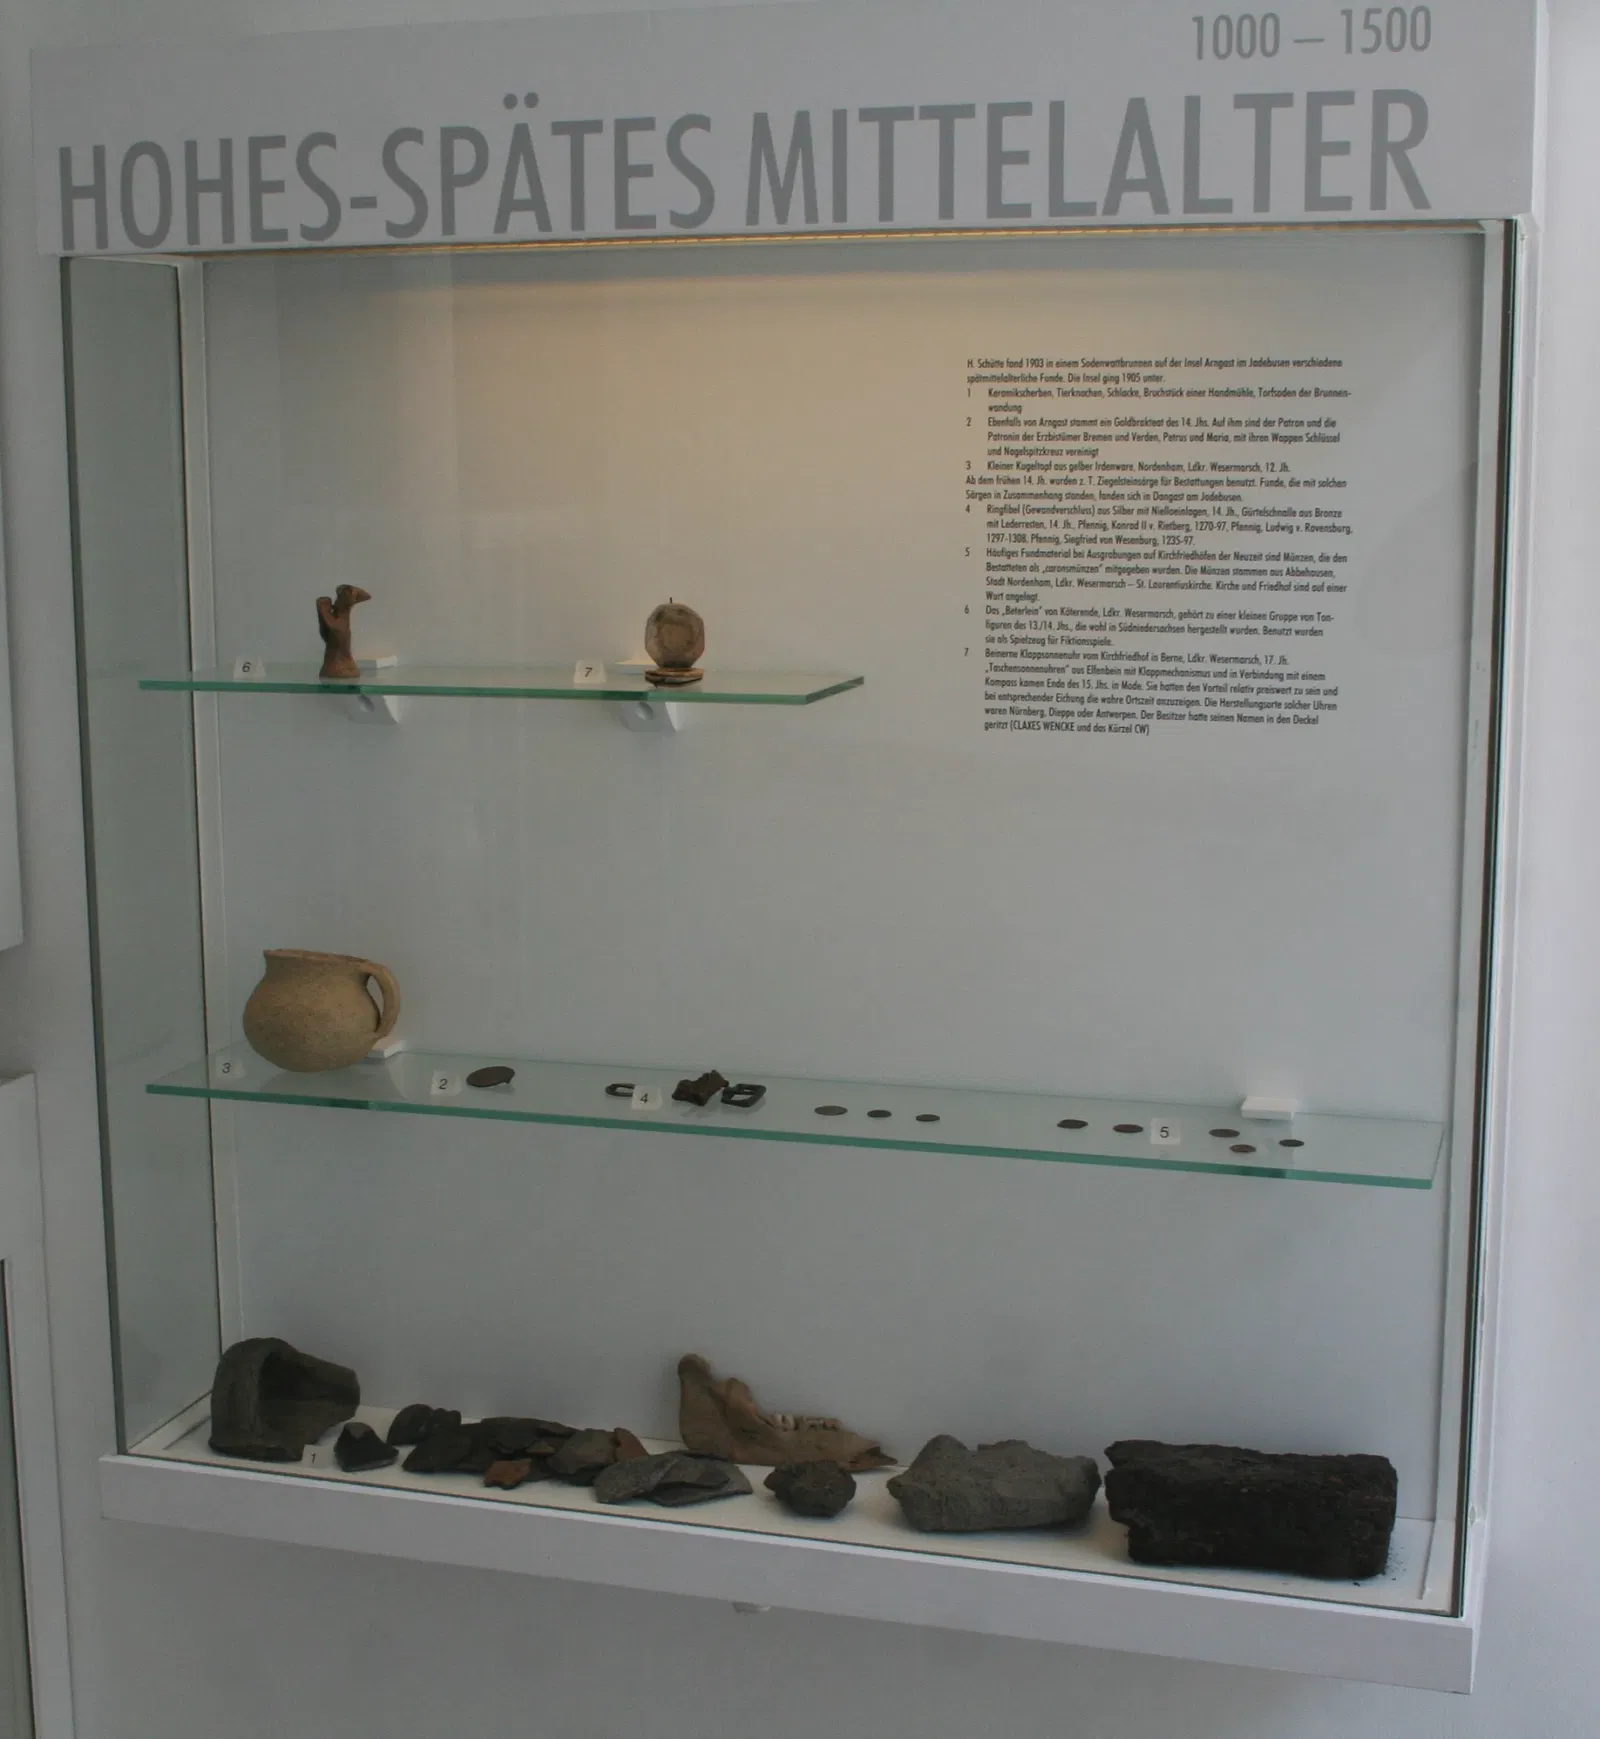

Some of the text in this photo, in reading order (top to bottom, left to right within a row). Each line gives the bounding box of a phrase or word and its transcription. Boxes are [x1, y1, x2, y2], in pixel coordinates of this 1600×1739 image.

[1192, 12, 1281, 61] 1000
[1341, 5, 1432, 54] 1500
[58, 88, 1431, 251] HOHES-SPÄTES MITTELALTER
[977, 357, 1342, 370] Schütte fand 1903 einem Insel Arngast Jadebusen verschiedene
[1082, 373, 1100, 383] Insel
[1102, 373, 1120, 385] ging
[987, 388, 1053, 399] Keramikscherben,
[1056, 388, 1104, 399] Tierknochen,
[1106, 388, 1141, 399] Schlacke,
[1142, 388, 1184, 398] Bruchstück
[1185, 388, 1206, 398] einer
[1208, 388, 1254, 399] Handmühle,
[1313, 388, 1352, 398] Brunnen-
[988, 402, 1022, 415] wandung
[987, 417, 1021, 427] Ebenfalls
[1038, 417, 1068, 430] Arngast
[1069, 417, 1098, 427] stammt
[1277, 417, 1304, 428] Patron
[987, 432, 1340, 445] Patronin Erzbistümer Bremen Verden, Petrus ihren Wappen Schlüssel
[1065, 446, 1099, 459] vereinigt
[986, 460, 1261, 474] Kleiner Kugeltopf gelber Nordenham, Wesermarsch,
[995, 475, 1020, 485] frühen
[1049, 475, 1078, 486] wurden
[1096, 476, 1158, 489] Ziegelsteinsärge
[1173, 476, 1224, 489] Bestattungen
[1259, 477, 1285, 489] Funde,
[1317, 477, 1346, 488] solchen
[965, 489, 992, 502] Särgen
[1002, 490, 1063, 503] Zusammenhang
[1064, 490, 1096, 502] standen,
[1098, 490, 1125, 501] fanden
[1152, 491, 1184, 504] Dangast
[986, 504, 1020, 517] Ringfibel
[1021, 504, 1095, 518] (Gewandverschluss)
[1112, 505, 1134, 516] Silber
[1241, 506, 1297, 517] Gürtelschnalle
[1314, 507, 1342, 517] Bronze
[1000, 519, 1352, 535] Lederresten, Pfennig, Konrad Rietberg, Pfennig, Ludwig Ravensburg,
[1030, 534, 1060, 547] Pfennig,
[1063, 534, 1098, 547] Siegfried
[1114, 535, 1159, 548] Wesenburg,
[985, 548, 1315, 564] Häufiges Fundmaterial Ausgrabungen Kirchfriedhöfen Neuzeit Münzen,
[985, 562, 1027, 573] Bestatteten
[1104, 564, 1150, 577] mitgegeben
[1199, 565, 1230, 576] Münzen
[1232, 566, 1268, 577] stammen
[1284, 567, 1334, 579] Abbehausen,
[985, 576, 1005, 587] Stadt
[1006, 577, 1052, 589] Nordenham,
[1076, 578, 1126, 589] Wesermarsch
[1215, 580, 1240, 591] Kirche
[1258, 581, 1292, 592] Friedhof
[1326, 582, 1346, 593] einer
[1124, 608, 1298, 624] Wesermarsch, gehört einer kleinen Gruppe
[984, 619, 1012, 633] figuren
[1118, 622, 1185, 634] Südniedersachsen
[1186, 623, 1227, 637] hergestellt
[1262, 625, 1292, 636] Benutzt
[1294, 626, 1323, 637] wurden
[1009, 634, 1046, 647] Spielzeug
[984, 648, 1262, 666] Beinerne Klappsonnenuhr Kirchfriedhof Wesermarsch,
[242, 661, 252, 673] 6
[585, 666, 593, 678] 7
[1086, 665, 1326, 683] Elfenbein Klappmechanismus Verbindung einem
[984, 677, 1292, 698] Kompass kamen hatten Vorteil relativ preiswert
[997, 691, 1053, 705] entsprechender
[1055, 693, 1085, 706] Eichung
[1100, 694, 1124, 705] wahre
[1125, 695, 1154, 706] Ortszeit
[1219, 697, 1282, 712] Herstellungsorte
[1283, 699, 1310, 710] solcher
[1312, 700, 1337, 711] Uhren
[984, 707, 1007, 716] waren
[1008, 705, 1045, 719] Nürnberg,
[1048, 707, 1075, 720] Dieppe
[1155, 710, 1186, 721] Besitzer
[1187, 711, 1208, 722] hatte
[1209, 711, 1234, 722] seinen
[1236, 712, 1264, 723] Namen
[1292, 714, 1319, 725] Deckel
[984, 719, 1132, 734] geritzt WENCKE Kürzel
[222, 1062, 231, 1074] 3
[439, 1078, 448, 1090] 2
[640, 1093, 649, 1104] 4
[1160, 1126, 1169, 1139] 5
[311, 1453, 317, 1464] 1
